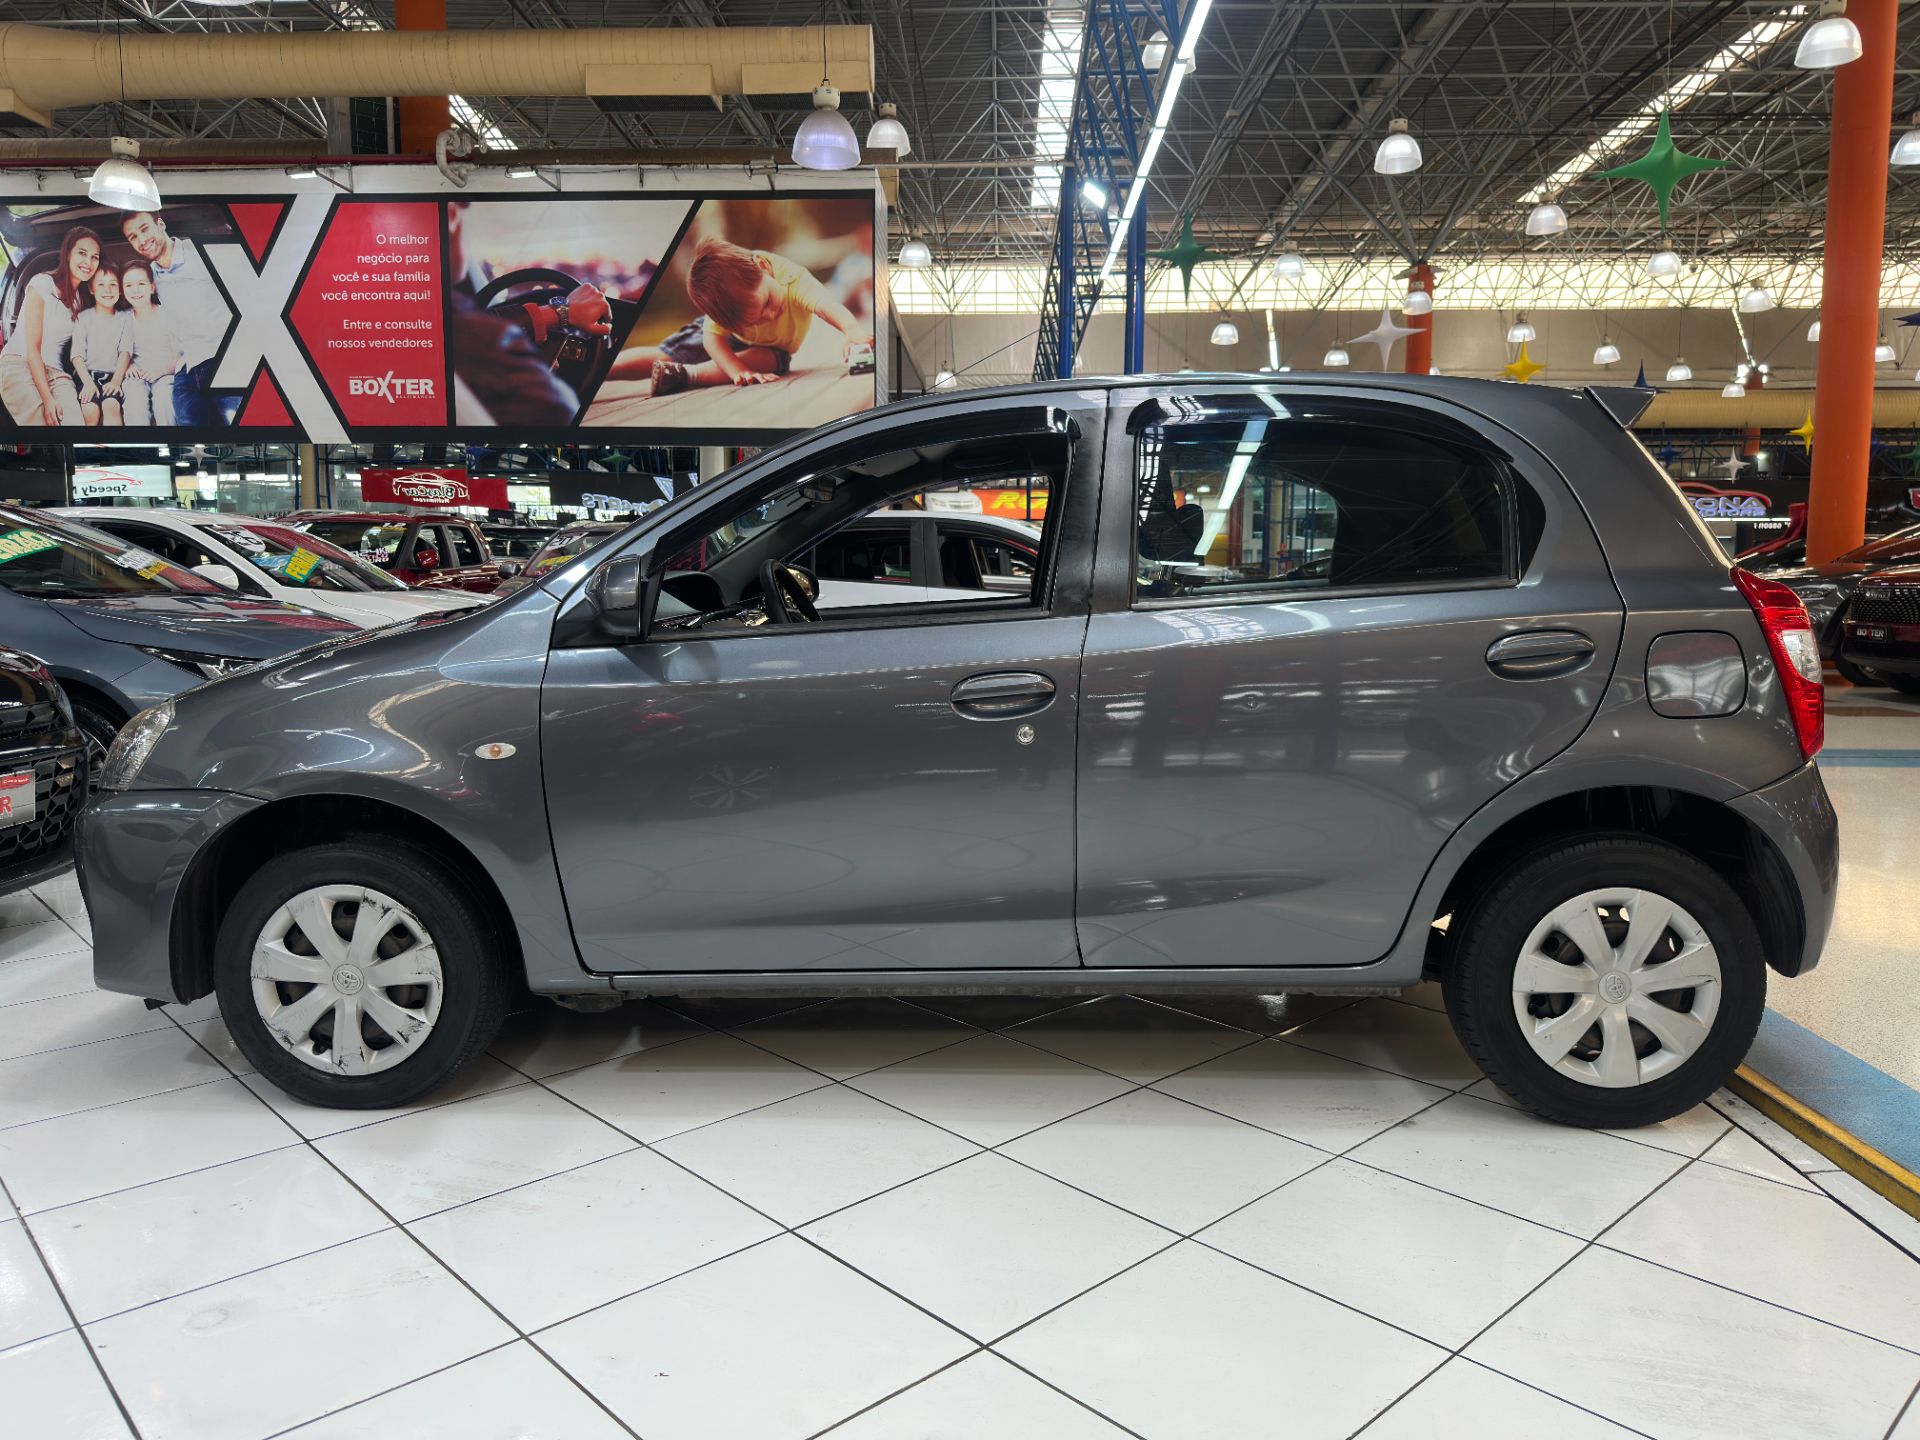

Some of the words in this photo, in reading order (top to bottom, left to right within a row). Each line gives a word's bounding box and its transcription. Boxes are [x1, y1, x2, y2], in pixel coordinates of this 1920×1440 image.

[376, 233, 387, 245] O
[389, 233, 430, 245] melhor
[357, 252, 403, 266] negócio
[405, 254, 430, 266] para
[332, 271, 360, 282] você
[362, 273, 369, 282] e
[371, 273, 391, 282] sua
[394, 271, 431, 282] família
[321, 290, 348, 301] você
[350, 292, 401, 301] encontra
[403, 289, 431, 303] aqui!
[343, 319, 372, 330] Entre
[375, 321, 382, 330] e
[384, 319, 433, 330] consulte
[328, 339, 366, 349] nossos
[368, 337, 433, 349] vendedores
[348, 370, 435, 404] BOXTER
